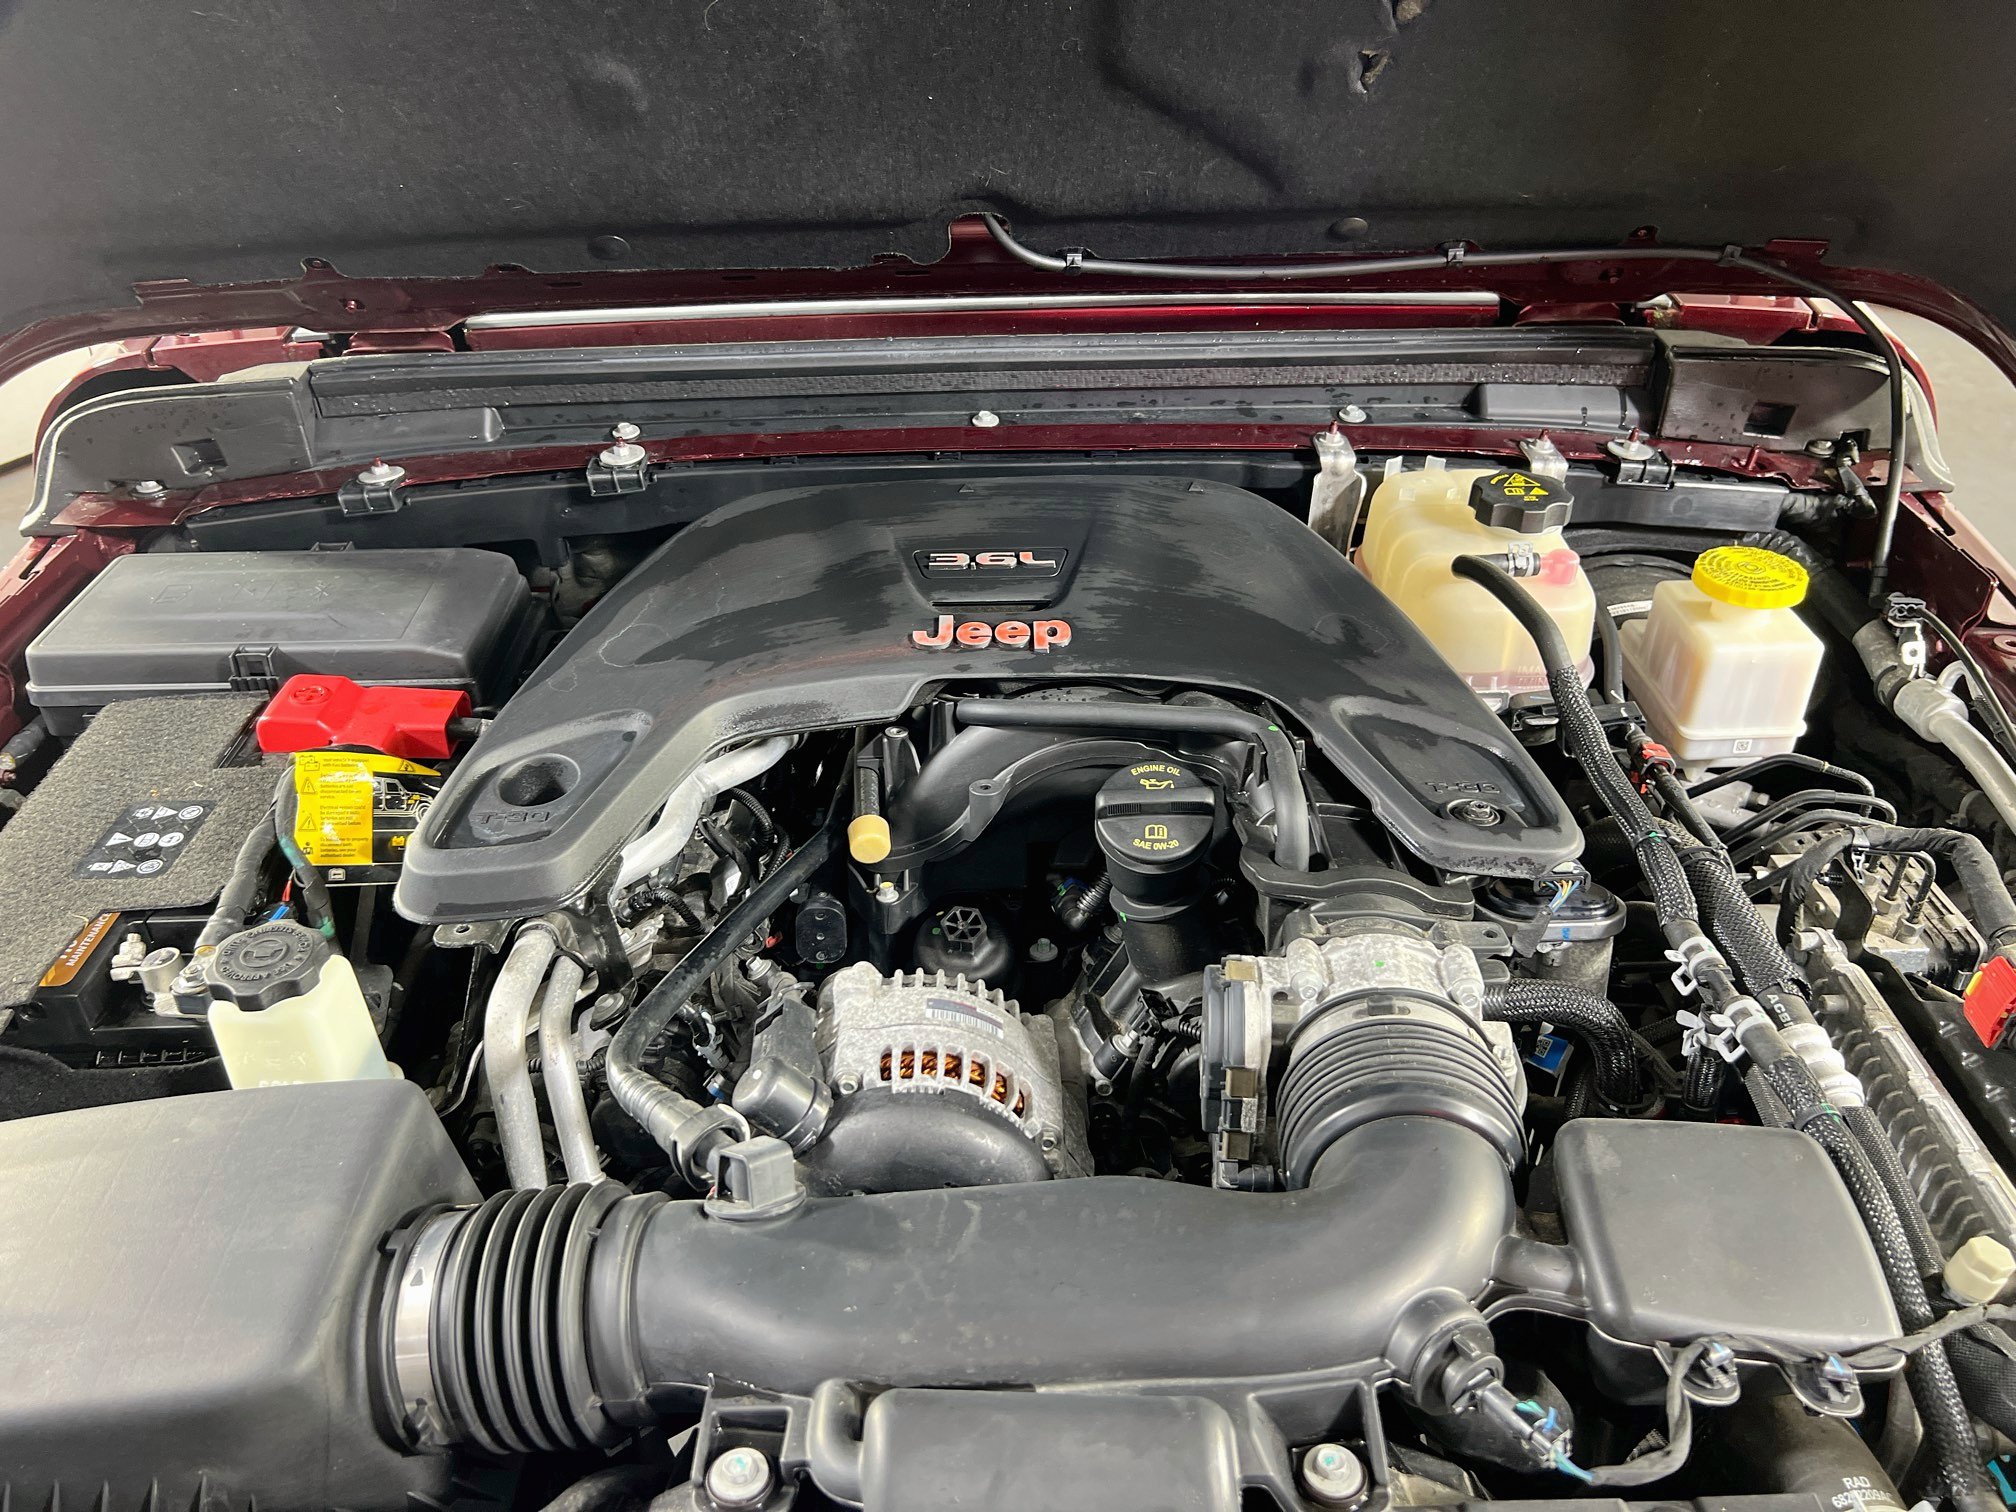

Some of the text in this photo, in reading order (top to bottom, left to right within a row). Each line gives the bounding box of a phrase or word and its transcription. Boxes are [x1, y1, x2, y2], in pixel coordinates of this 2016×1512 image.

[928, 551, 1057, 571] 3.6L
[912, 614, 1072, 654] Jeep
[1130, 764, 1181, 777] ENGINE OIL
[1132, 838, 1180, 851] SAE 0W-20
[1841, 1476, 1871, 1490] RAD
